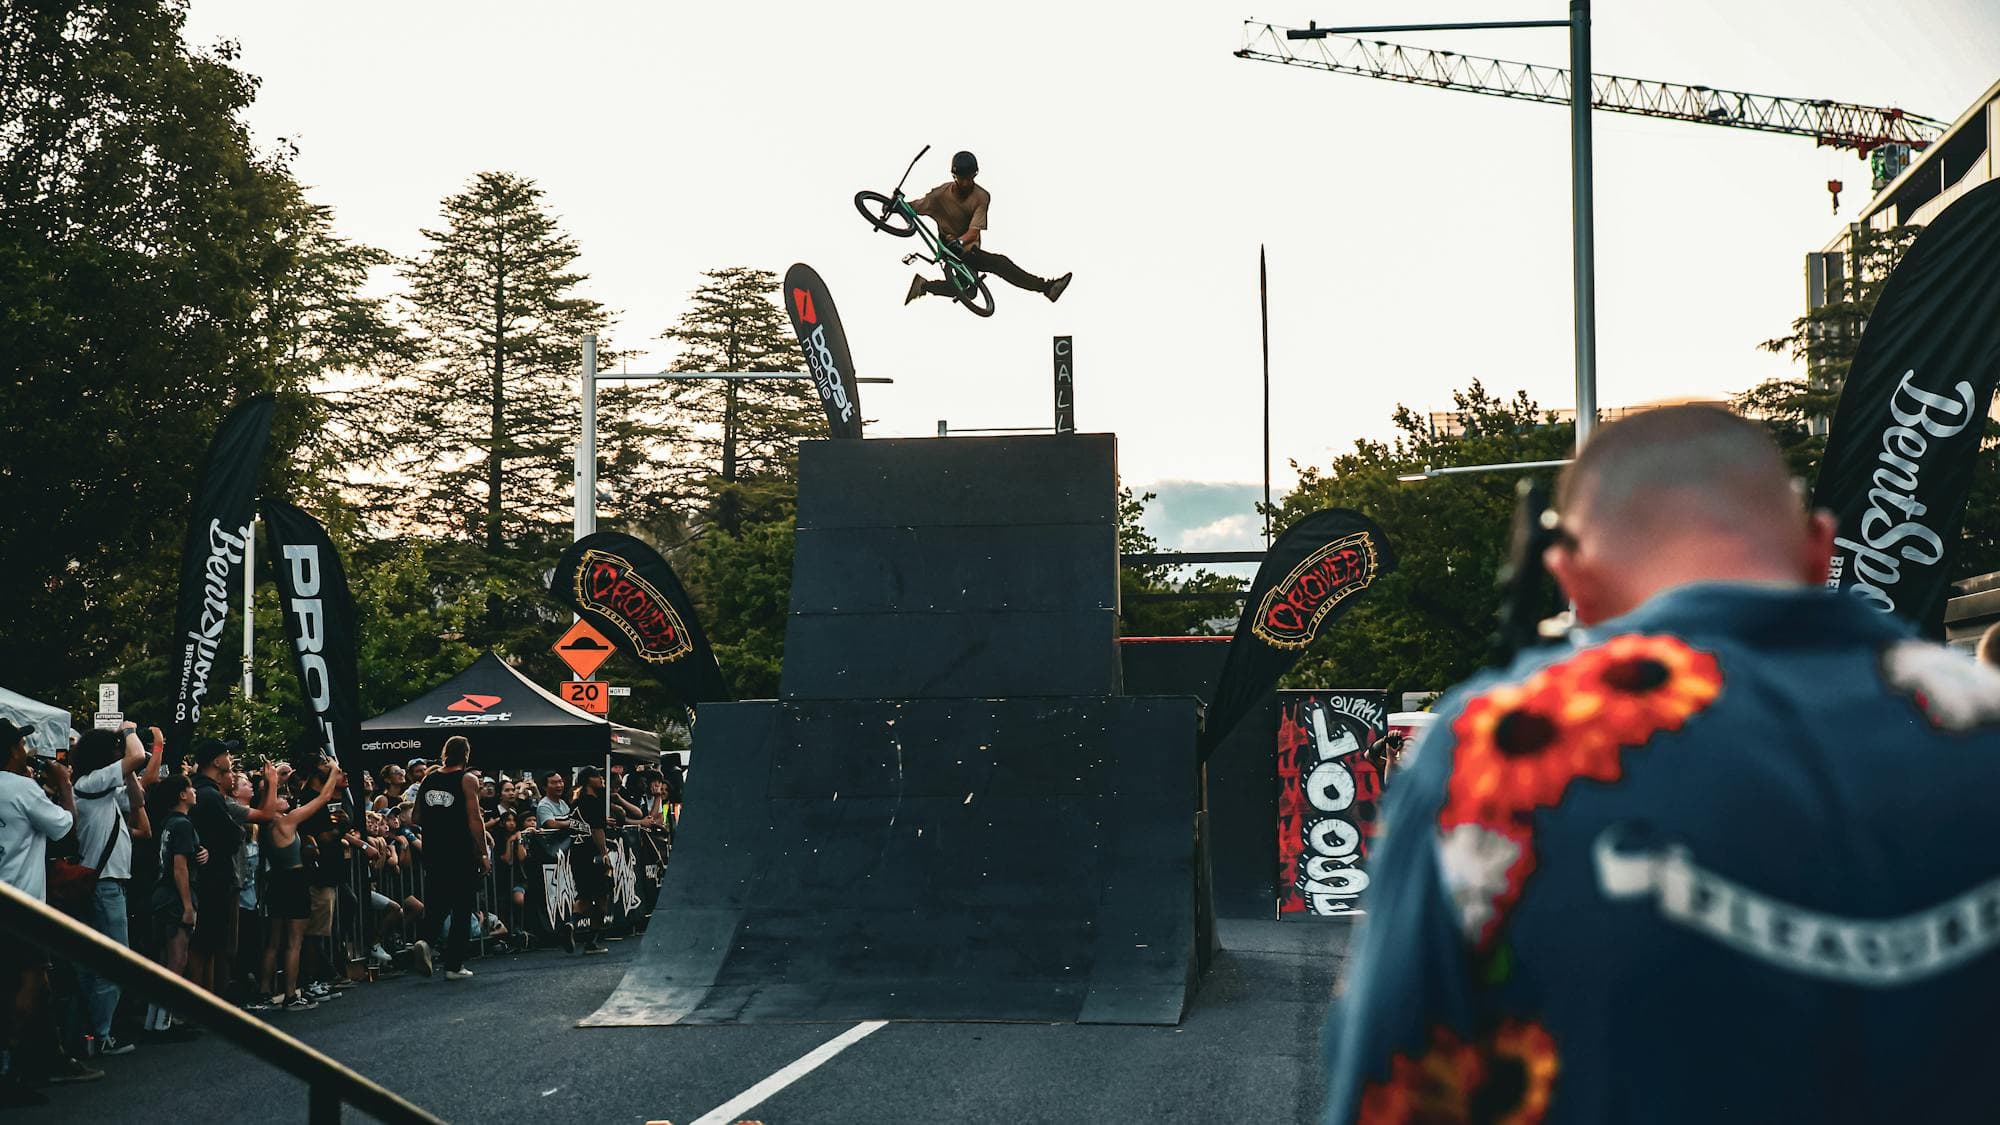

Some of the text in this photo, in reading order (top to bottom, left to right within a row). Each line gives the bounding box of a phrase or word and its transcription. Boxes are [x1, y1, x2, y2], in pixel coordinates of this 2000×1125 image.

[802, 337, 831, 400] mobile
[811, 324, 854, 423] boost
[1056, 340, 1072, 433] CALL
[1834, 369, 1976, 613] BentSpo
[1268, 549, 1360, 630] DROVER
[1313, 587, 1352, 624] PROJECTS
[1825, 556, 1845, 593] BRE
[599, 606, 638, 641] PROJECTS
[174, 643, 195, 724] BREWING CO.
[571, 684, 599, 701] 20
[361, 739, 422, 751] ostmobile
[424, 712, 512, 724] boost
[1303, 708, 1370, 916] LOOSE
